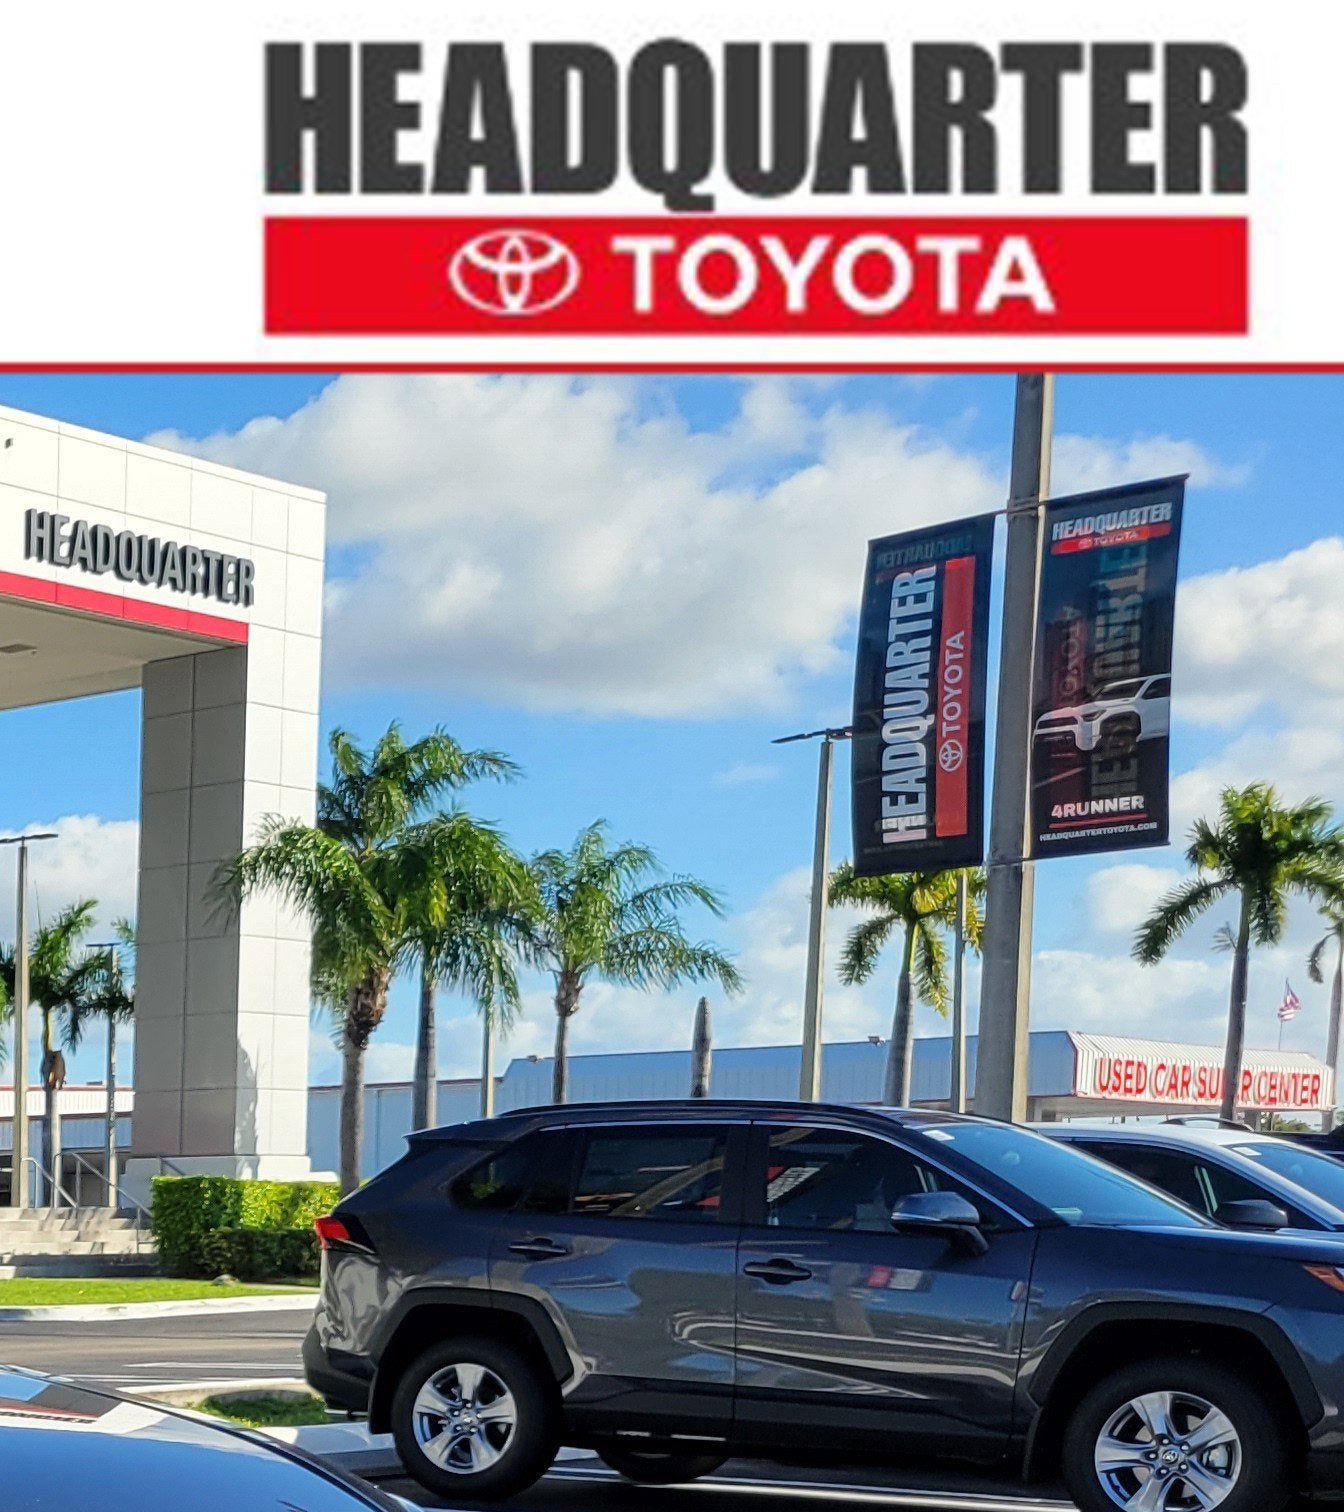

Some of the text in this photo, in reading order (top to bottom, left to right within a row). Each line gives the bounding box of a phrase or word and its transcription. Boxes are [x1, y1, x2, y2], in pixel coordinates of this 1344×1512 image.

[1051, 502, 1173, 541] HEADQUARTER
[1093, 530, 1139, 546] TOYOTA
[23, 508, 257, 607] HEADQUARTER
[882, 565, 937, 844] HEADQUARTER
[941, 631, 965, 737] TOYOTA
[1050, 795, 1145, 819] 4RUNNER
[1039, 821, 1158, 842] HEADQUARTERTOYOTA.COM
[1097, 1057, 1321, 1105] USED CAR SUR CENTER
